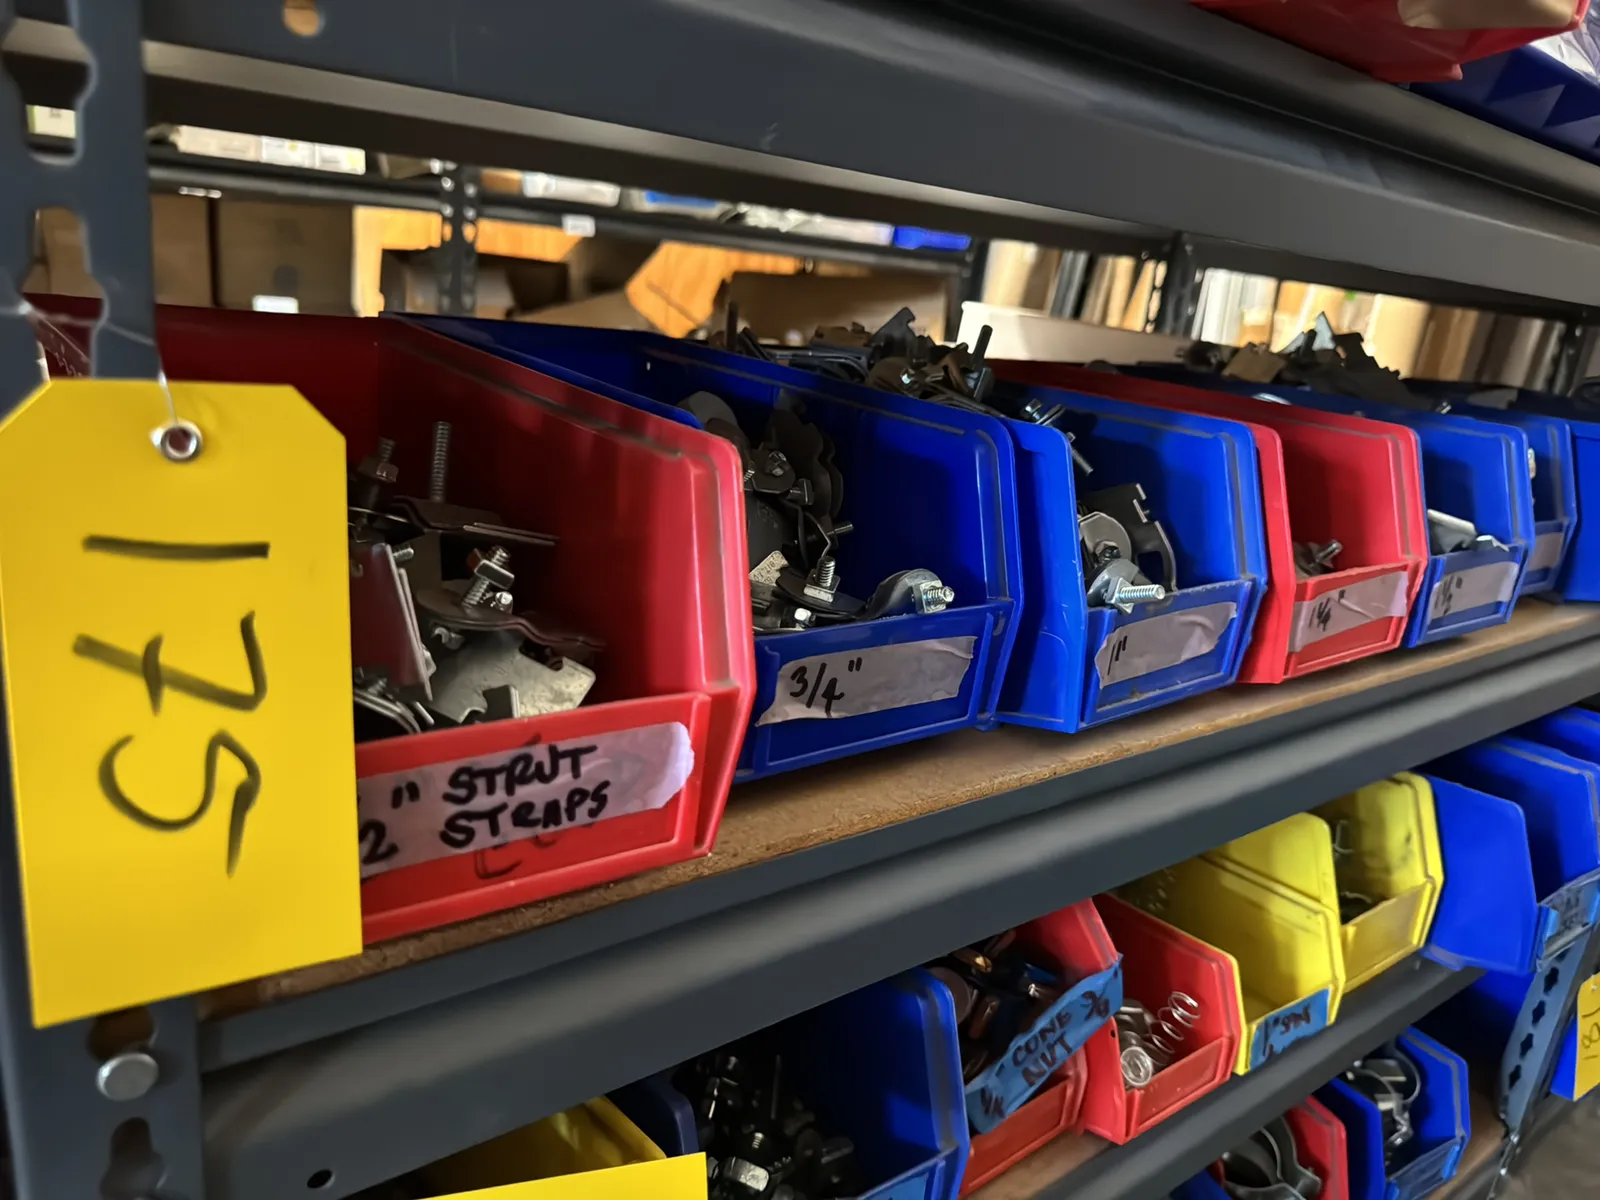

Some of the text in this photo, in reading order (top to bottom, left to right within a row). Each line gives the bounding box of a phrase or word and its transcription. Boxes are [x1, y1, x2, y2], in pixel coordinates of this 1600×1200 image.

[73, 534, 270, 878] 175
[442, 744, 599, 805] STRUT
[439, 779, 611, 849] STRAPS
[1011, 1010, 1073, 1068] CONE
[1021, 1030, 1073, 1087] NUT
